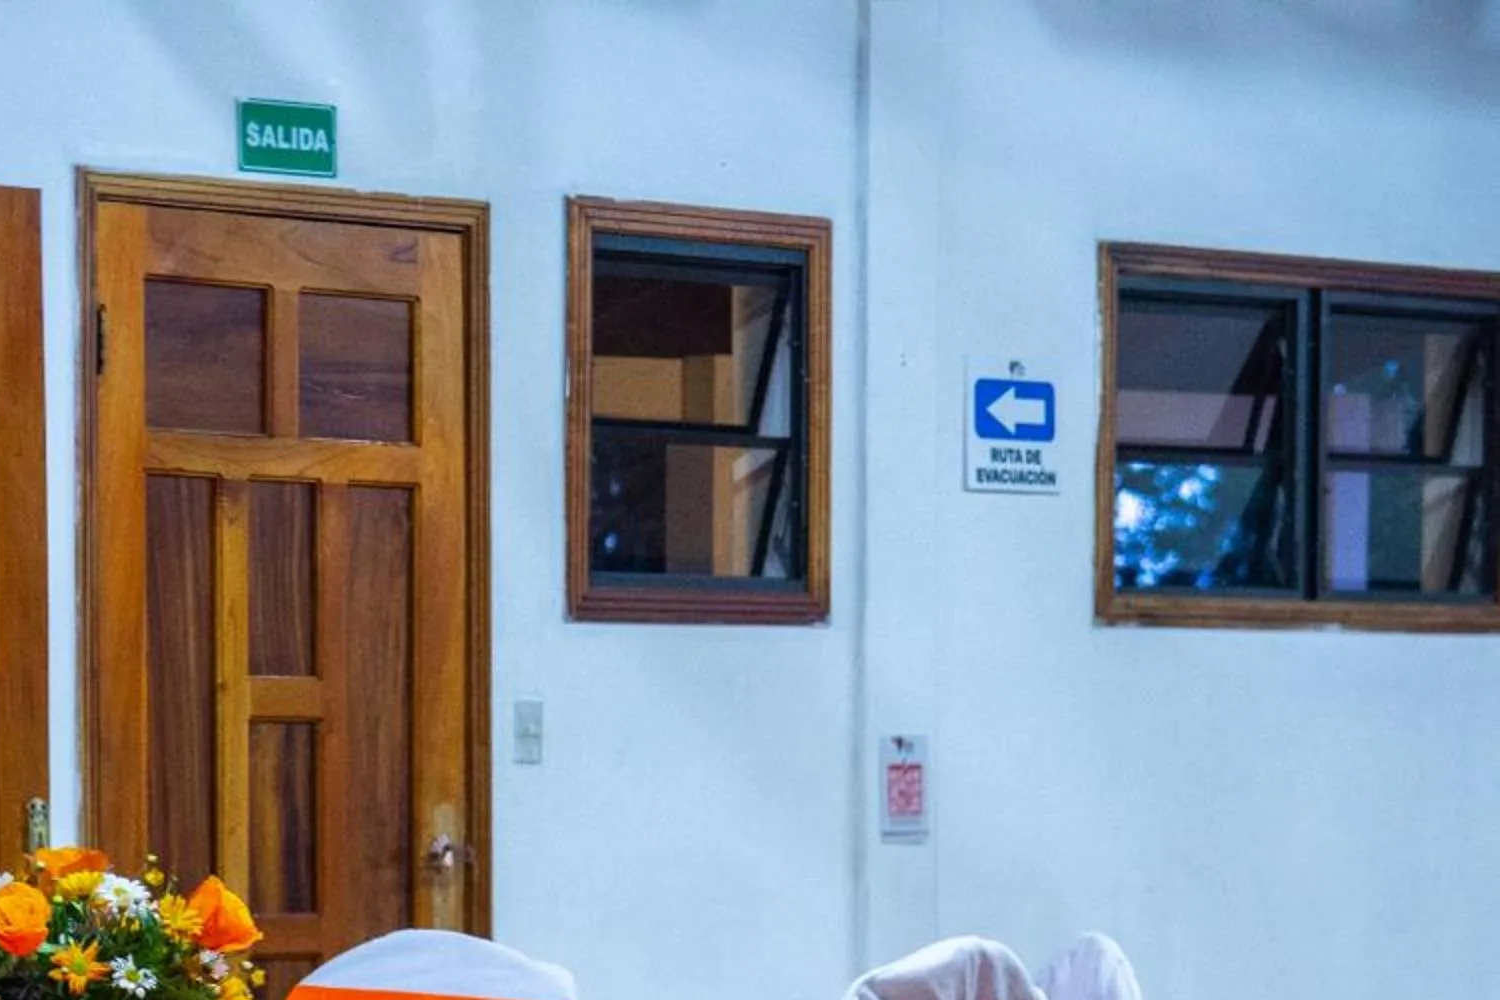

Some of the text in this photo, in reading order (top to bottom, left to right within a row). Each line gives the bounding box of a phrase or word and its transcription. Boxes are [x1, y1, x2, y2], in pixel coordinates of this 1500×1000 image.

[246, 121, 330, 153] SALIDA
[990, 447, 1042, 465] RUTA DE
[976, 466, 1057, 486] EVACUACIÓN
